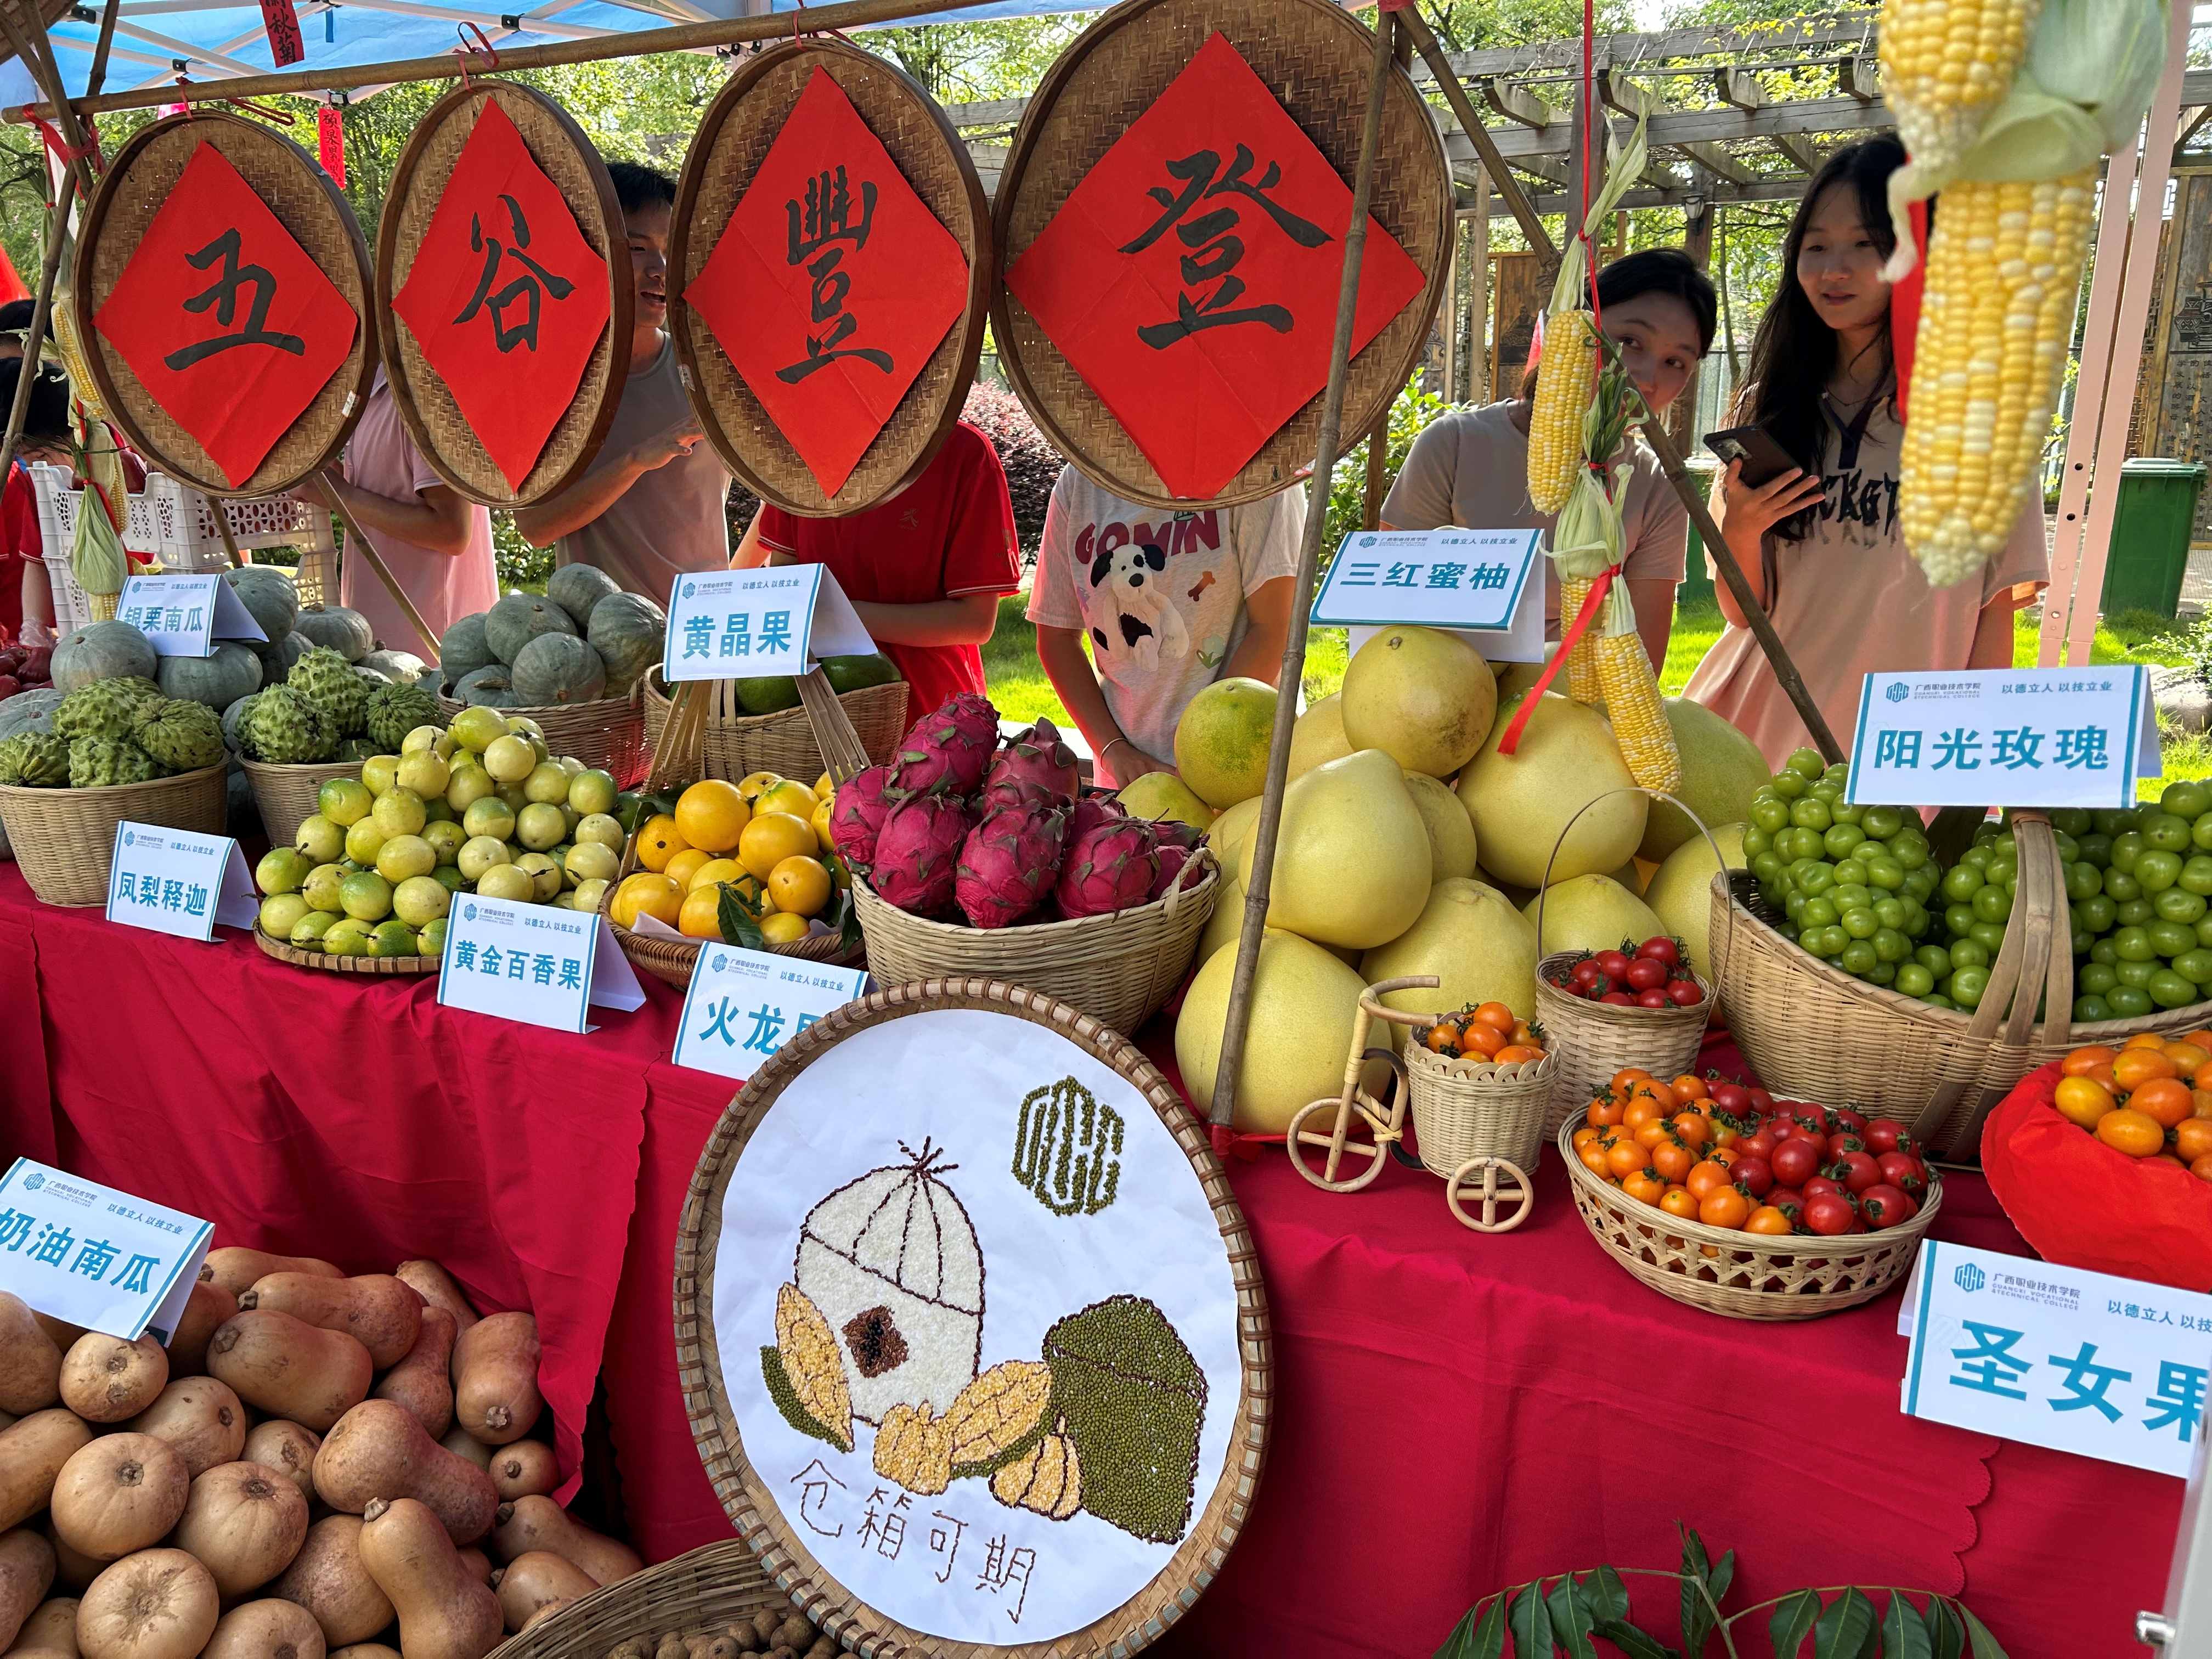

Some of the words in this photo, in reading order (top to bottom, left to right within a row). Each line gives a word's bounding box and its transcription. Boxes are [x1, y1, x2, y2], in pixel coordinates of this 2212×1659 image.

[265, 0, 299, 63] 秋菊
[1119, 143, 1333, 351] 登
[453, 195, 577, 353] 谷
[164, 228, 306, 371] 五
[1340, 562, 1510, 590] 三红蜜柚
[125, 606, 203, 632] 银栗南瓜
[682, 611, 791, 659] 黄晶果
[2002, 683, 2054, 693] 以德立人
[2058, 681, 2113, 692] 以技立业
[1875, 725, 2108, 770] 阳光玫瑰
[117, 872, 208, 916] 凤梨释迦
[524, 917, 552, 930] 以德立人
[554, 922, 582, 934] 以技立业
[455, 940, 582, 990] 黄金百香果
[780, 970, 810, 985] 以德立人
[812, 977, 844, 991] 以技立业
[699, 996, 822, 1056] 火龙
[106, 1203, 143, 1222] 以德立人
[145, 1216, 184, 1235] 以技立业
[1993, 1273, 2081, 1299] 广西职业技术学院
[2030, 1291, 2079, 1305] VOCATIONAL
[2044, 1299, 2079, 1311] COLLEGE
[2108, 1300, 2174, 1325] 以德立人
[1949, 1319, 2210, 1442] 圣女果
[791, 1458, 1036, 1624] 仓箱可期
